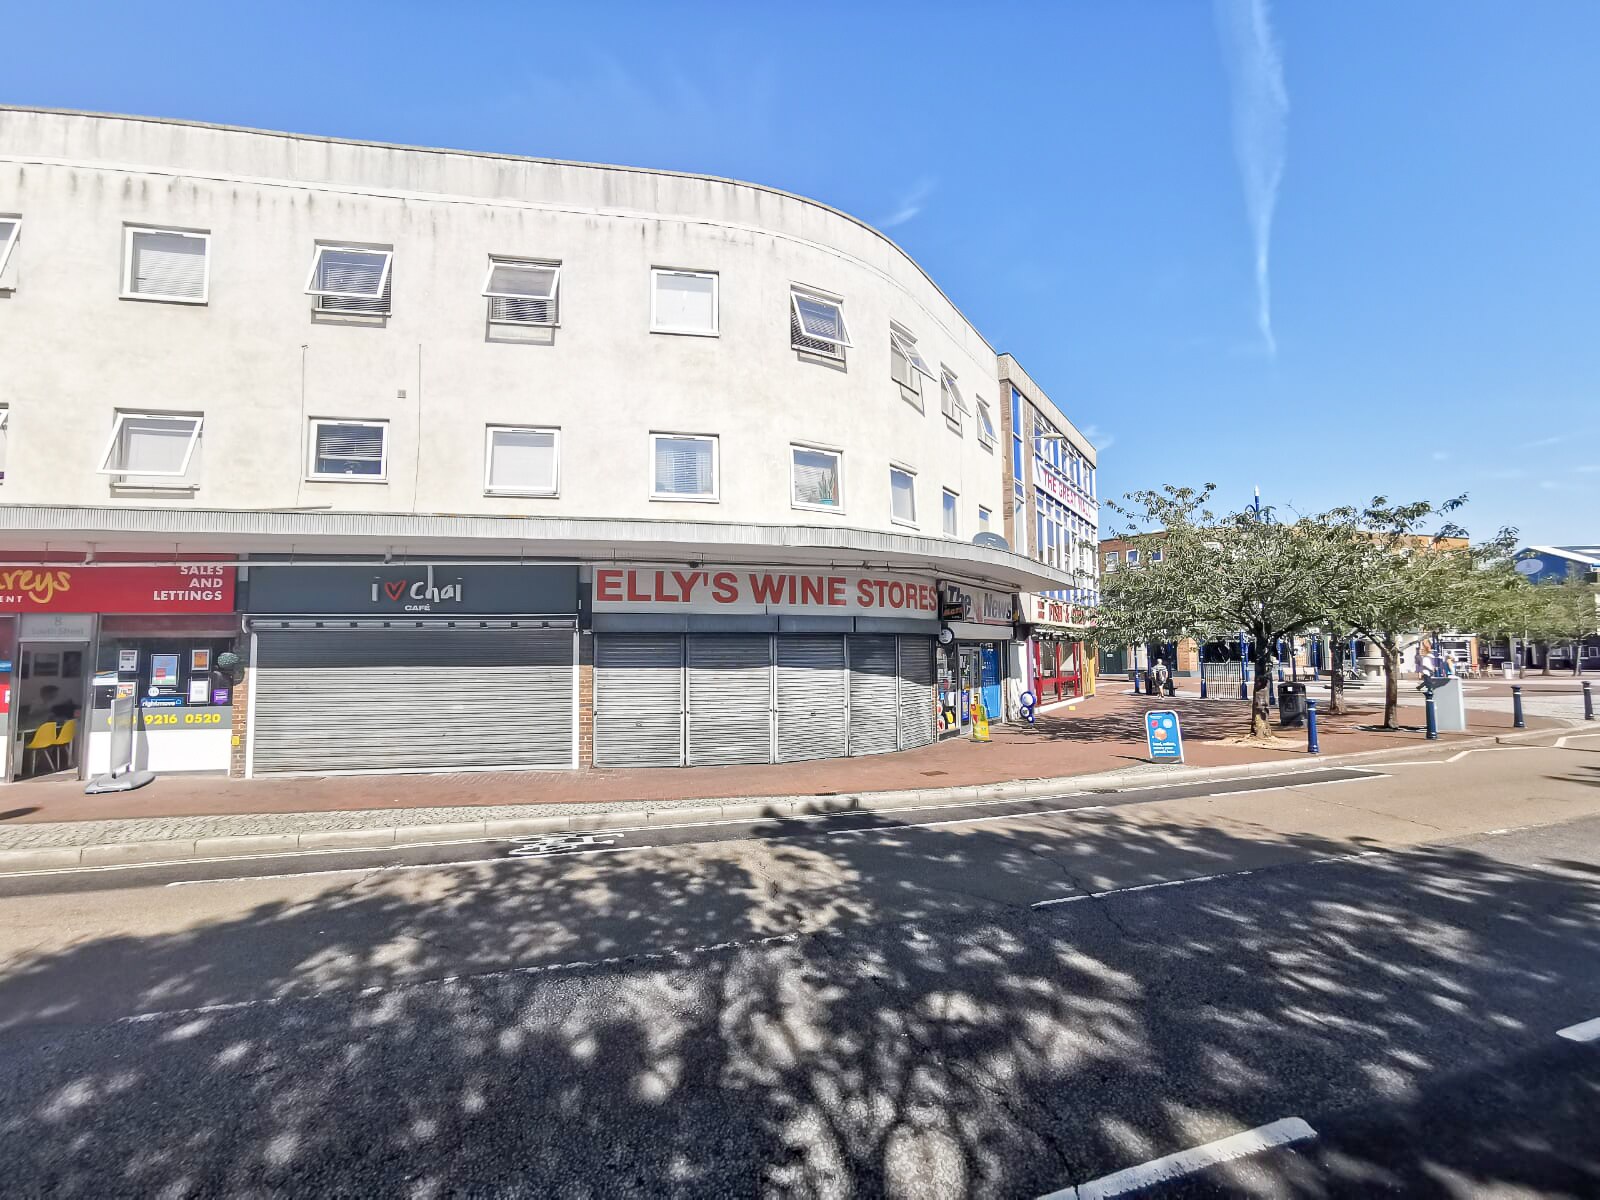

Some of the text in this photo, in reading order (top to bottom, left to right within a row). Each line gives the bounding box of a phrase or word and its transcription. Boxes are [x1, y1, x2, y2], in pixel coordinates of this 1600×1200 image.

[1043, 469, 1057, 494] THE
[180, 565, 223, 575] SALES
[189, 578, 223, 588] AND
[153, 590, 222, 601] LETTINGS
[596, 569, 937, 612] ELLY'S WINE STORES
[144, 714, 178, 726] 9216
[185, 713, 221, 724] 0520
